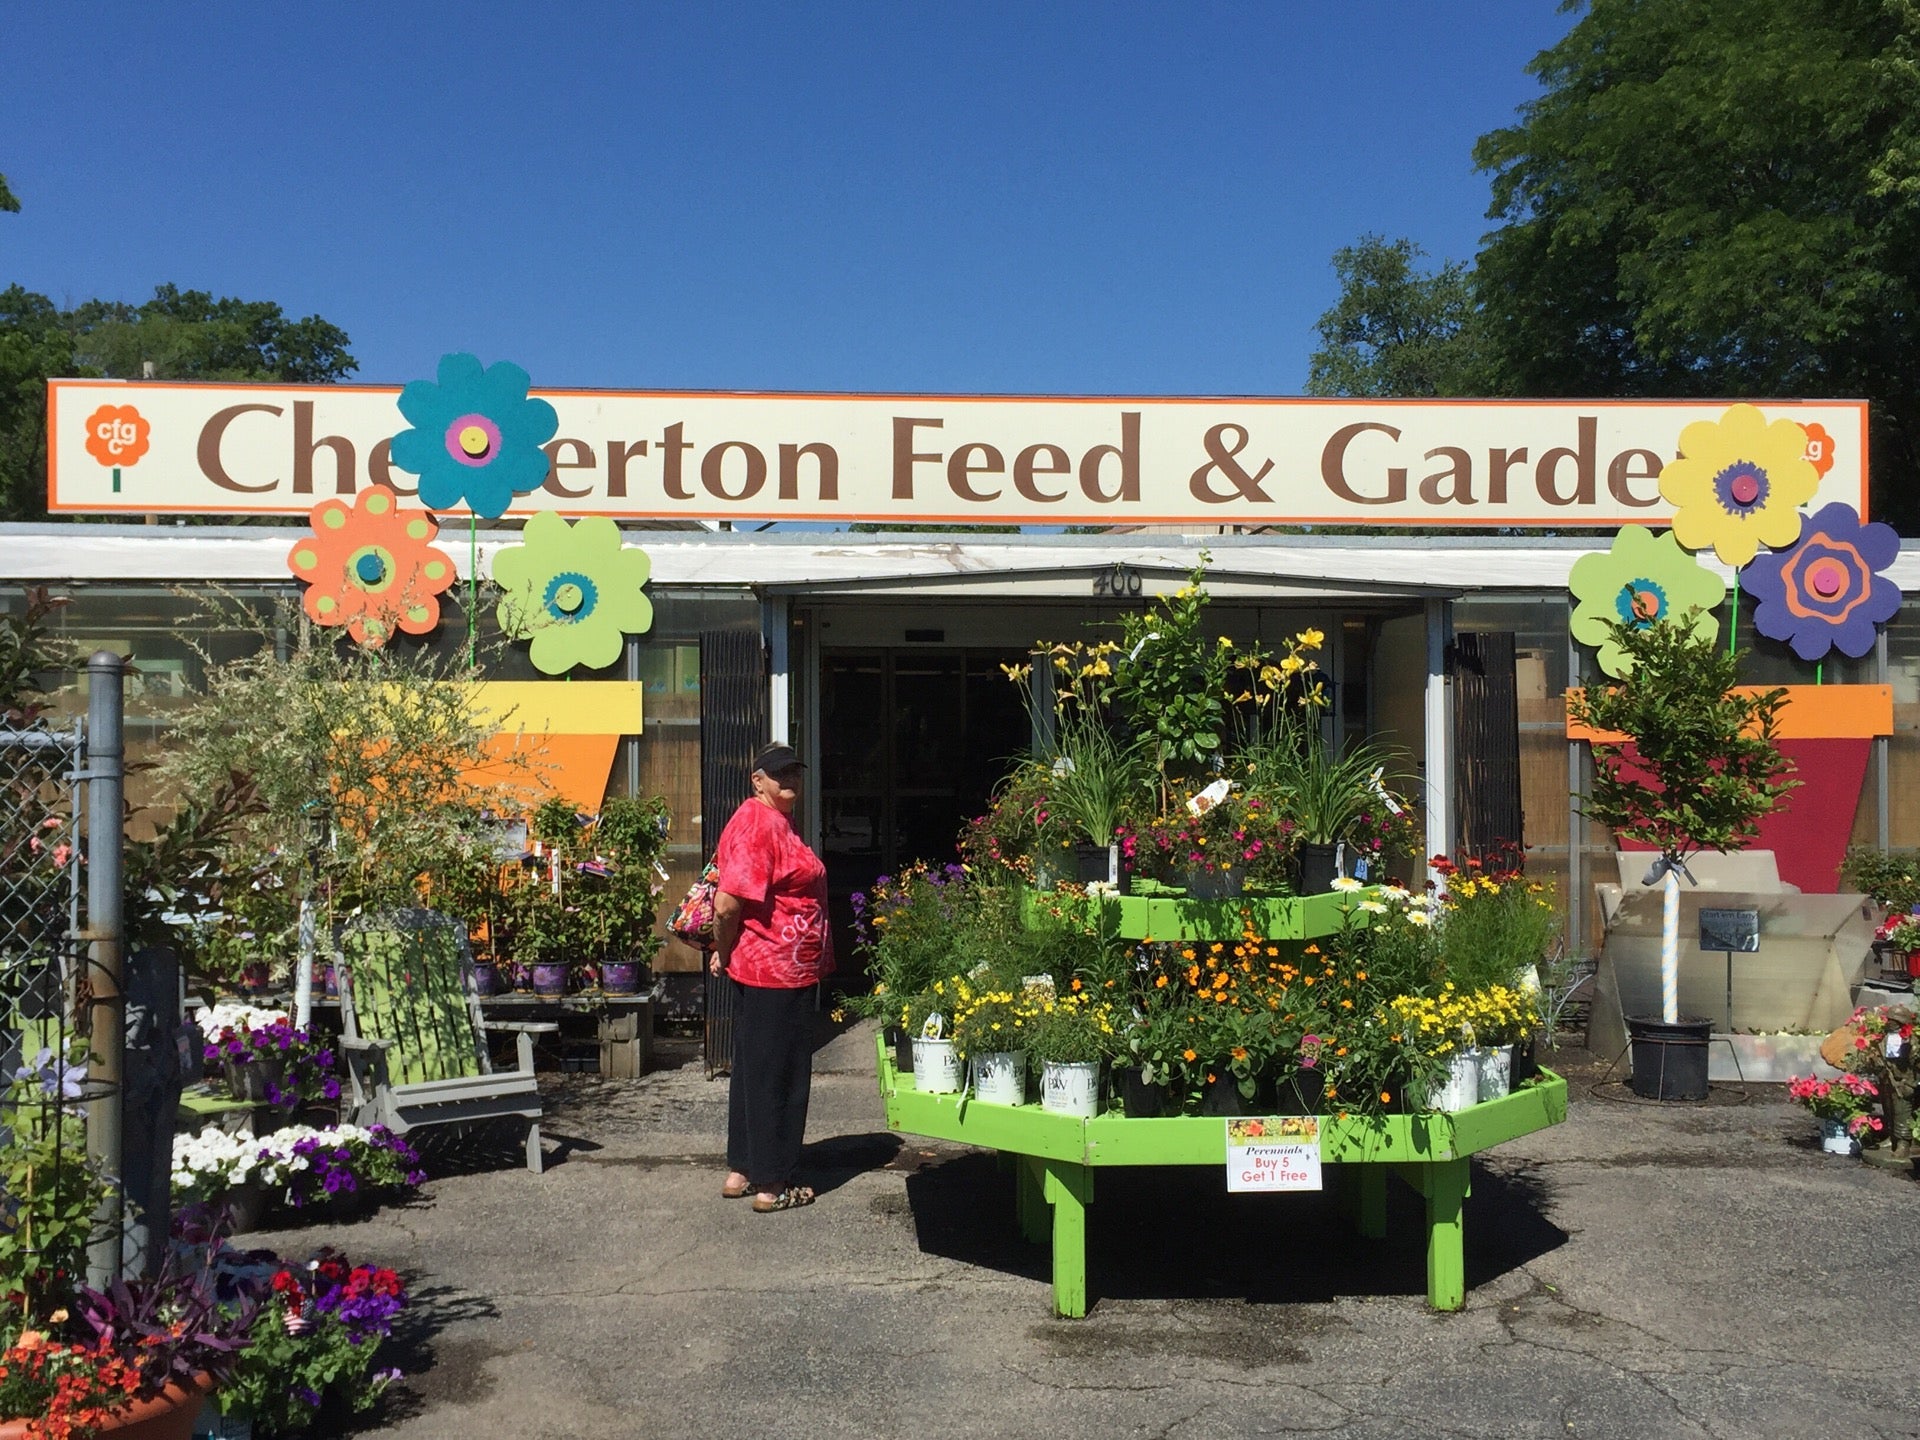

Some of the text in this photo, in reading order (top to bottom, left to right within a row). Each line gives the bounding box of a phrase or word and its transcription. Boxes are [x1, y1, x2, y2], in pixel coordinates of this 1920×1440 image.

[197, 400, 1686, 508] Cheerton Feed & Garde
[1246, 1146, 1303, 1155] Perennials
[1255, 1157, 1289, 1169] Buy 5
[1241, 1171, 1307, 1182] Get 1 Free
